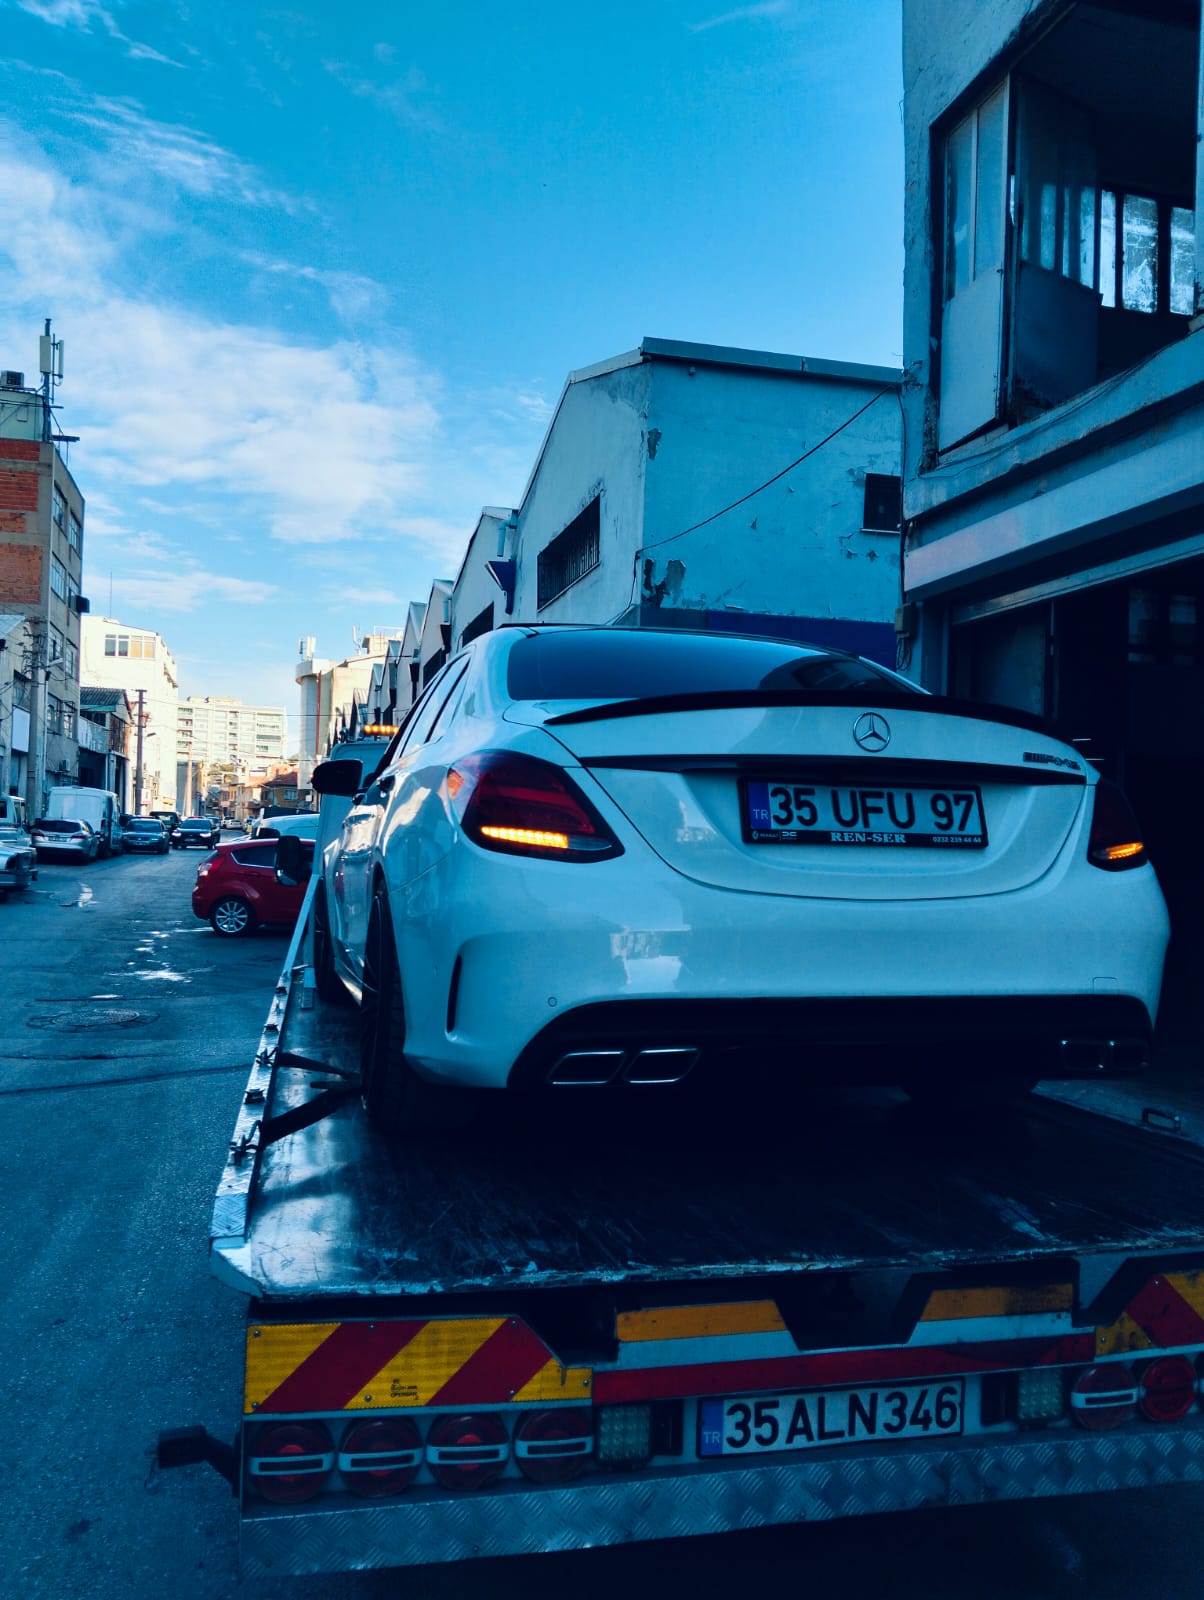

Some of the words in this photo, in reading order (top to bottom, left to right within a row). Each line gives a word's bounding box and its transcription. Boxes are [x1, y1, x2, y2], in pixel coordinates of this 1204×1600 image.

[753, 808, 769, 820] TR
[770, 787, 819, 826] 35
[831, 789, 916, 830] UFU
[930, 793, 975, 832] 97
[831, 832, 907, 843] REN-SER
[703, 1431, 720, 1444] TR
